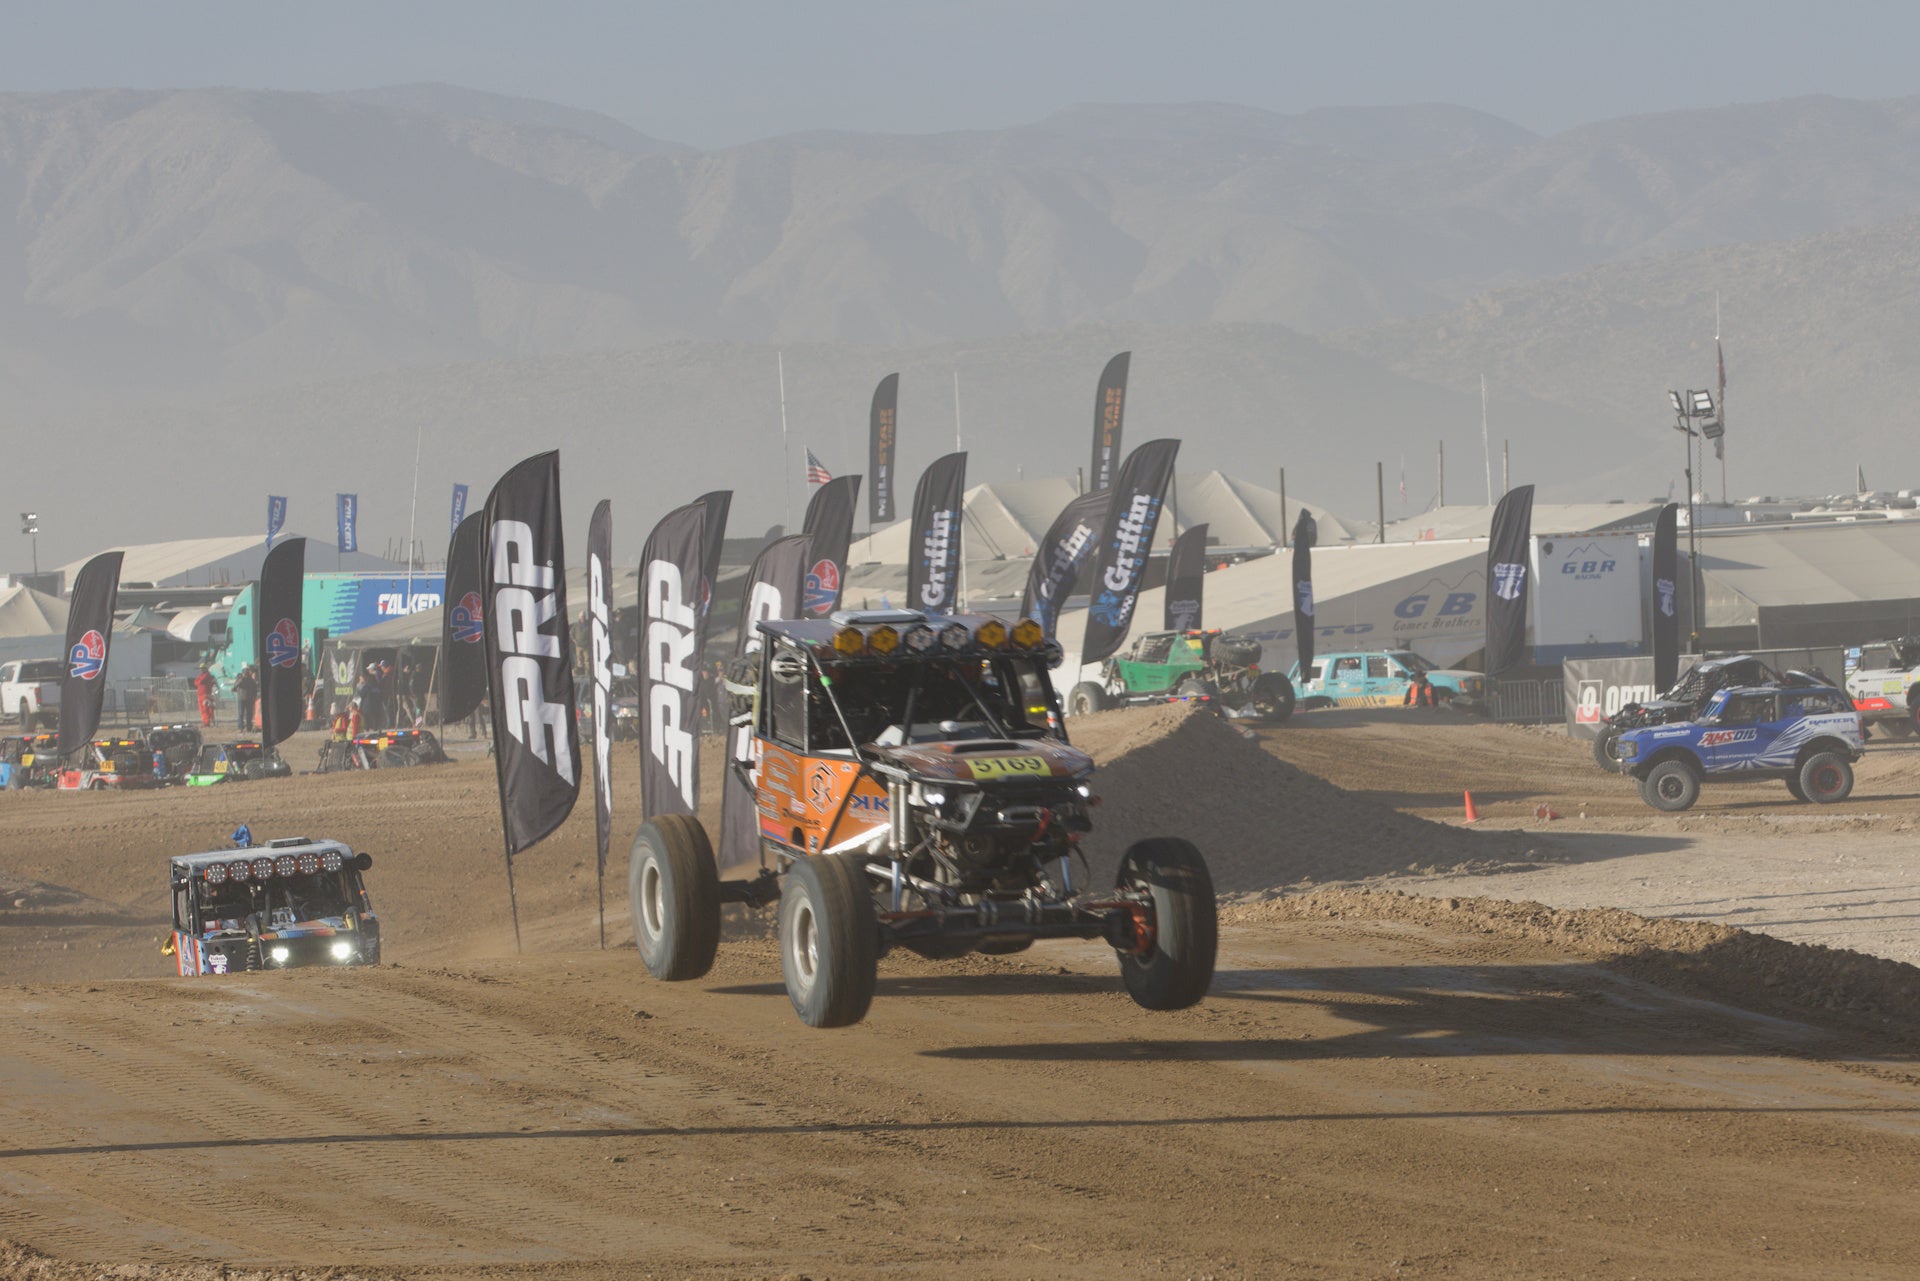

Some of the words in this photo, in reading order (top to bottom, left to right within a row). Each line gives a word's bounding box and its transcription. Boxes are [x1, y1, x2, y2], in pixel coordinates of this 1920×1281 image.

[921, 509, 952, 606] Griffin
[1103, 493, 1151, 592] Griffin
[378, 593, 441, 615] FALKEN
[70, 644, 102, 677] VP
[492, 520, 574, 787] PRP
[648, 560, 695, 810] PRP
[973, 758, 1042, 774] 5169
[1699, 727, 1757, 747] AMSOIL
